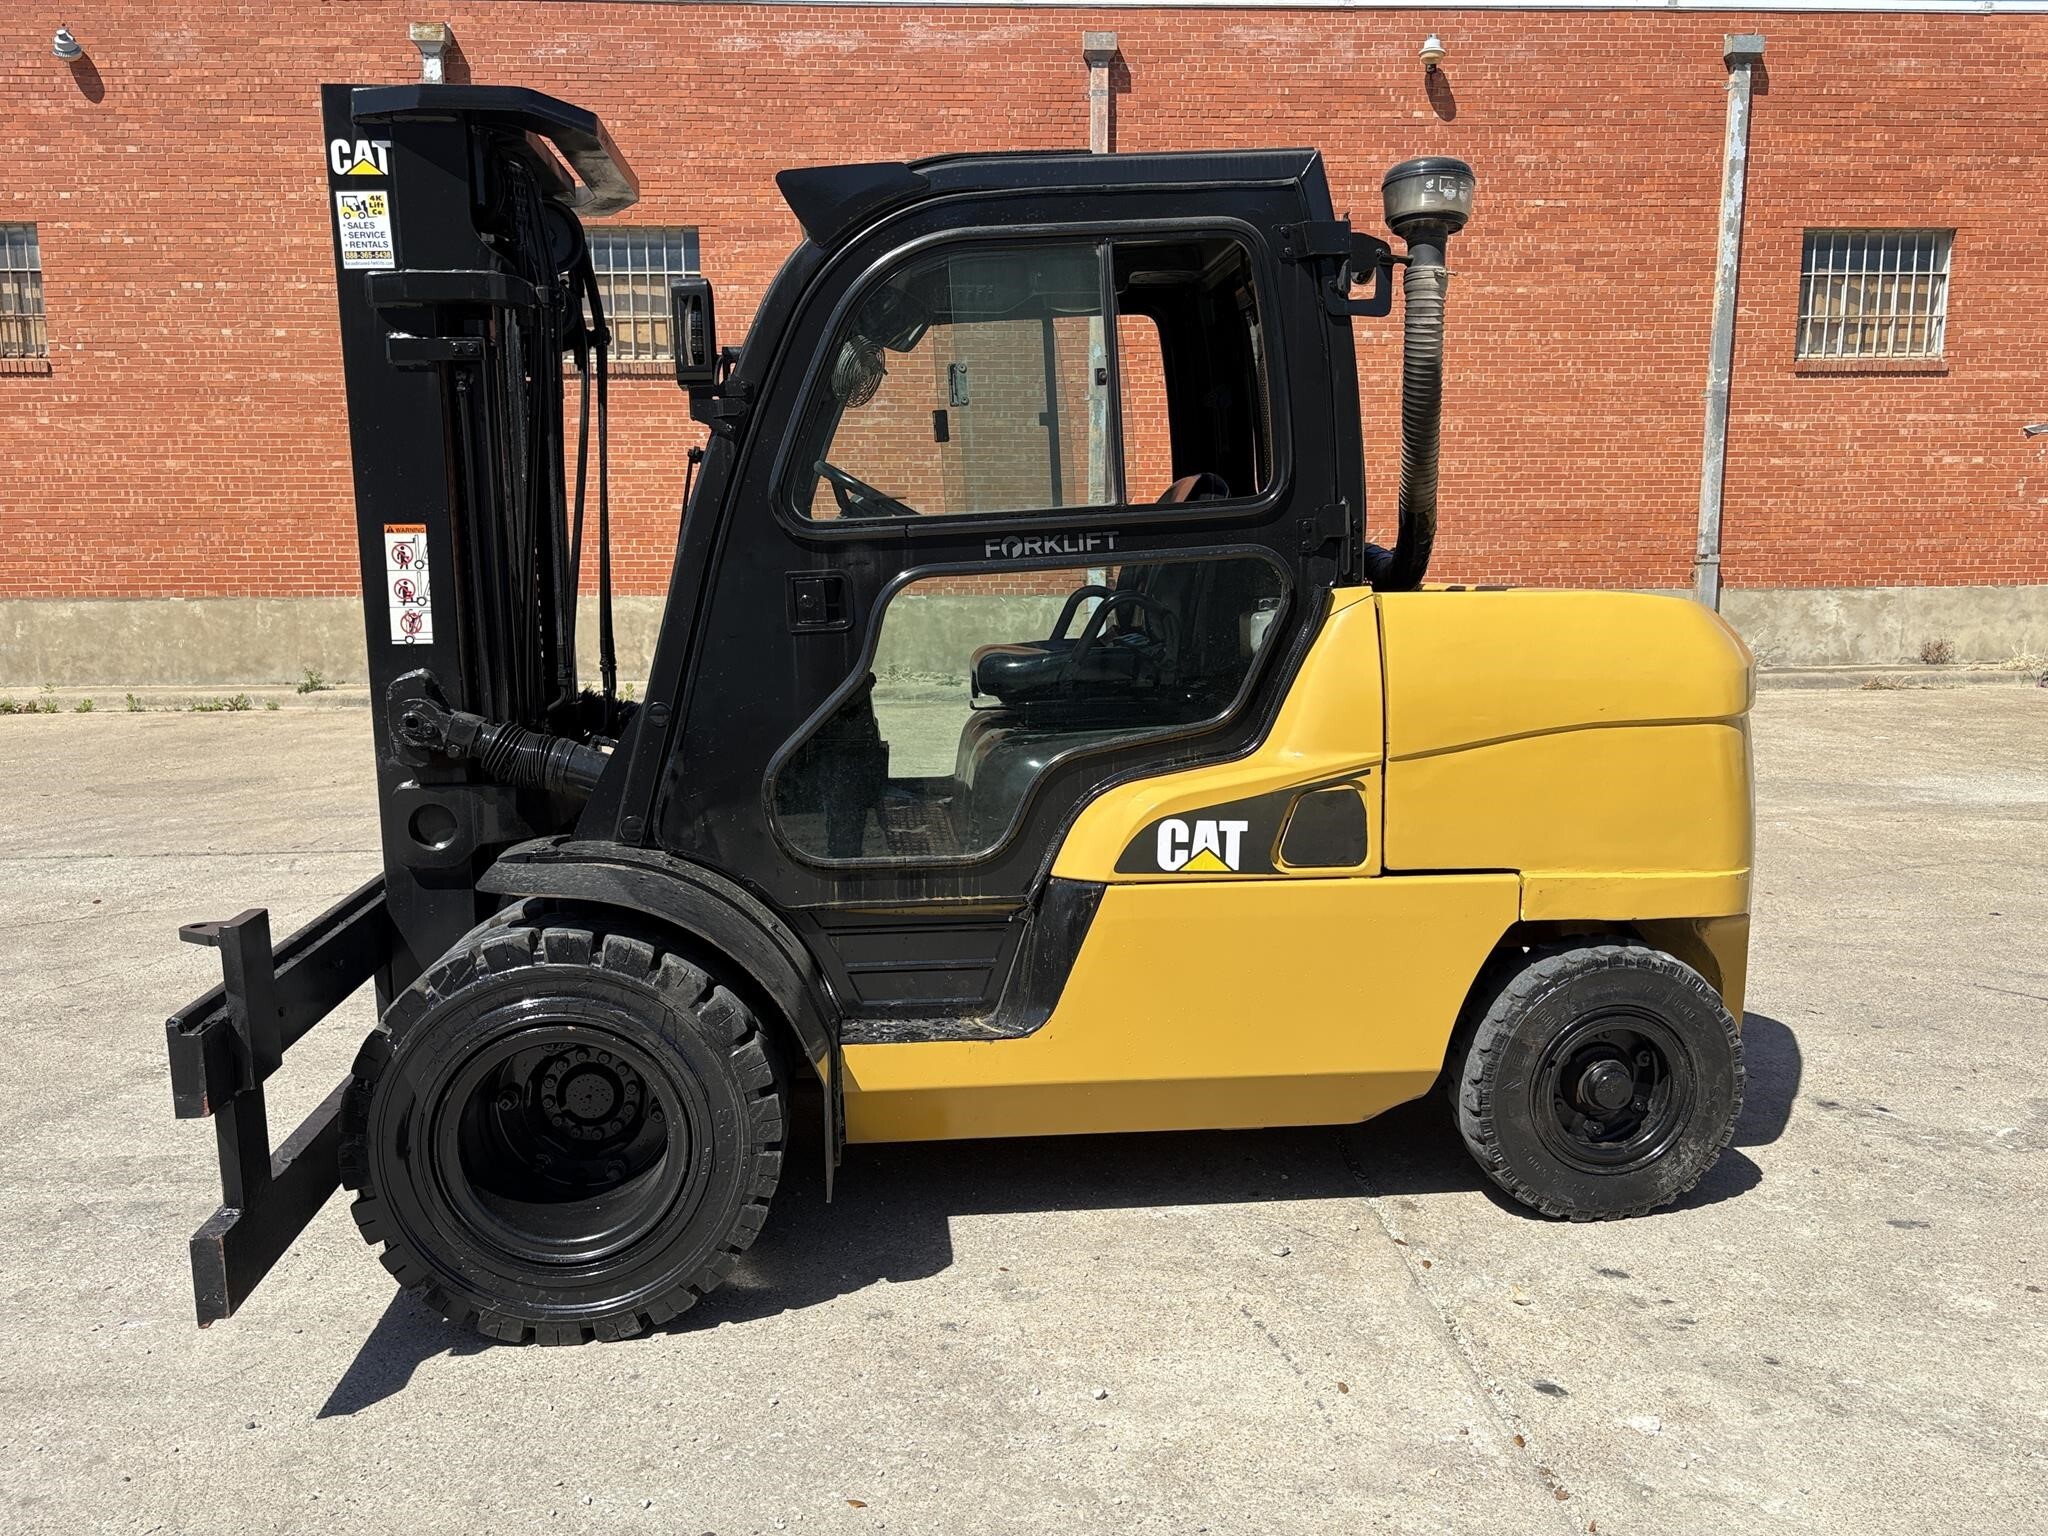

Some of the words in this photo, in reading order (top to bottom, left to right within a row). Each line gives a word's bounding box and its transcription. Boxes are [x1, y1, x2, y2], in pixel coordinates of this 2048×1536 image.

[331, 138, 391, 175] CAT
[348, 231, 386, 239] SERVICE
[349, 240, 389, 248] RENTALS
[985, 531, 1119, 558] FORKLIFT
[1157, 819, 1248, 871] CAT
